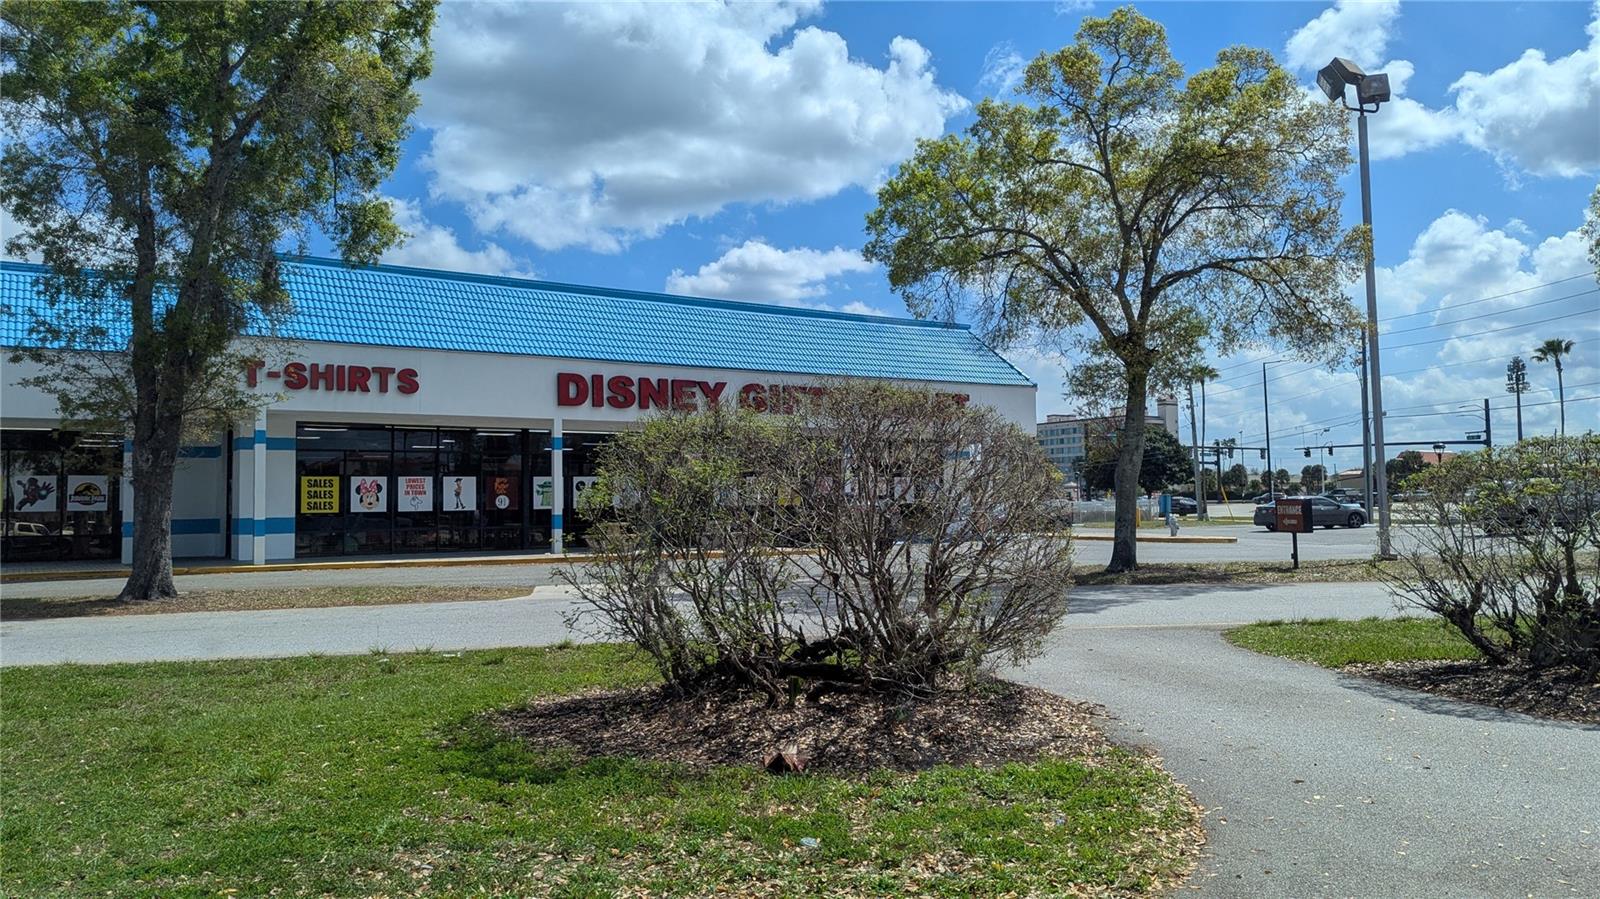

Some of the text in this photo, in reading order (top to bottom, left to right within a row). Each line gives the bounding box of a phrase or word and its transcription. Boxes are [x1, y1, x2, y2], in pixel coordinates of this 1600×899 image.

[240, 360, 420, 395] T-SHIRTS
[557, 373, 727, 413] DISNEY
[306, 479, 334, 488] SALES
[306, 490, 334, 499] SALES
[306, 501, 334, 510] SALES
[1277, 505, 1303, 515] ENTRANCE
